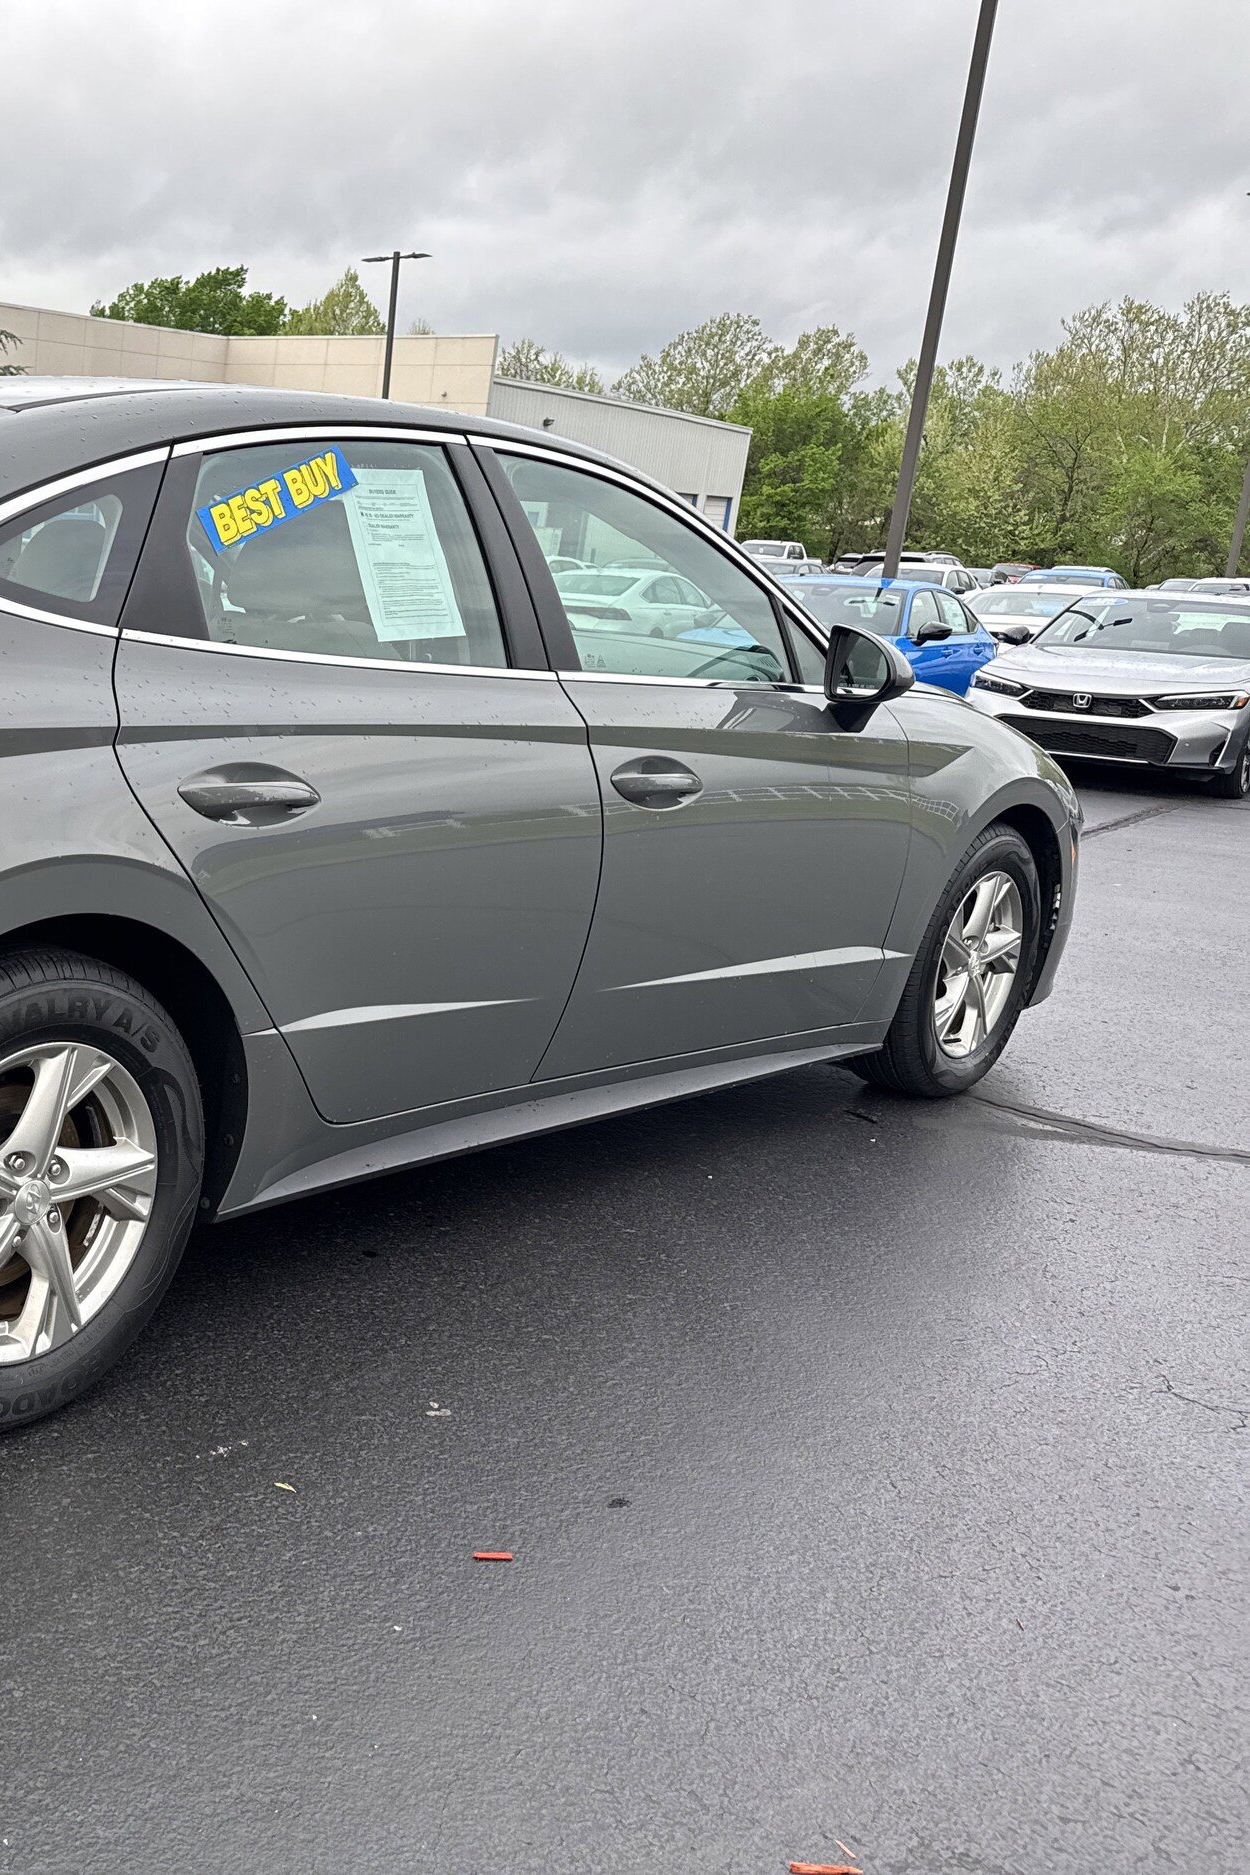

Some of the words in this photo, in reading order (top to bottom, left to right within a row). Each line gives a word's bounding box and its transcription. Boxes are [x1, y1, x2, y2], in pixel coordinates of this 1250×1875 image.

[209, 478, 283, 546] BEST
[282, 451, 343, 509] BUY
[111, 1006, 162, 1054] A/S
